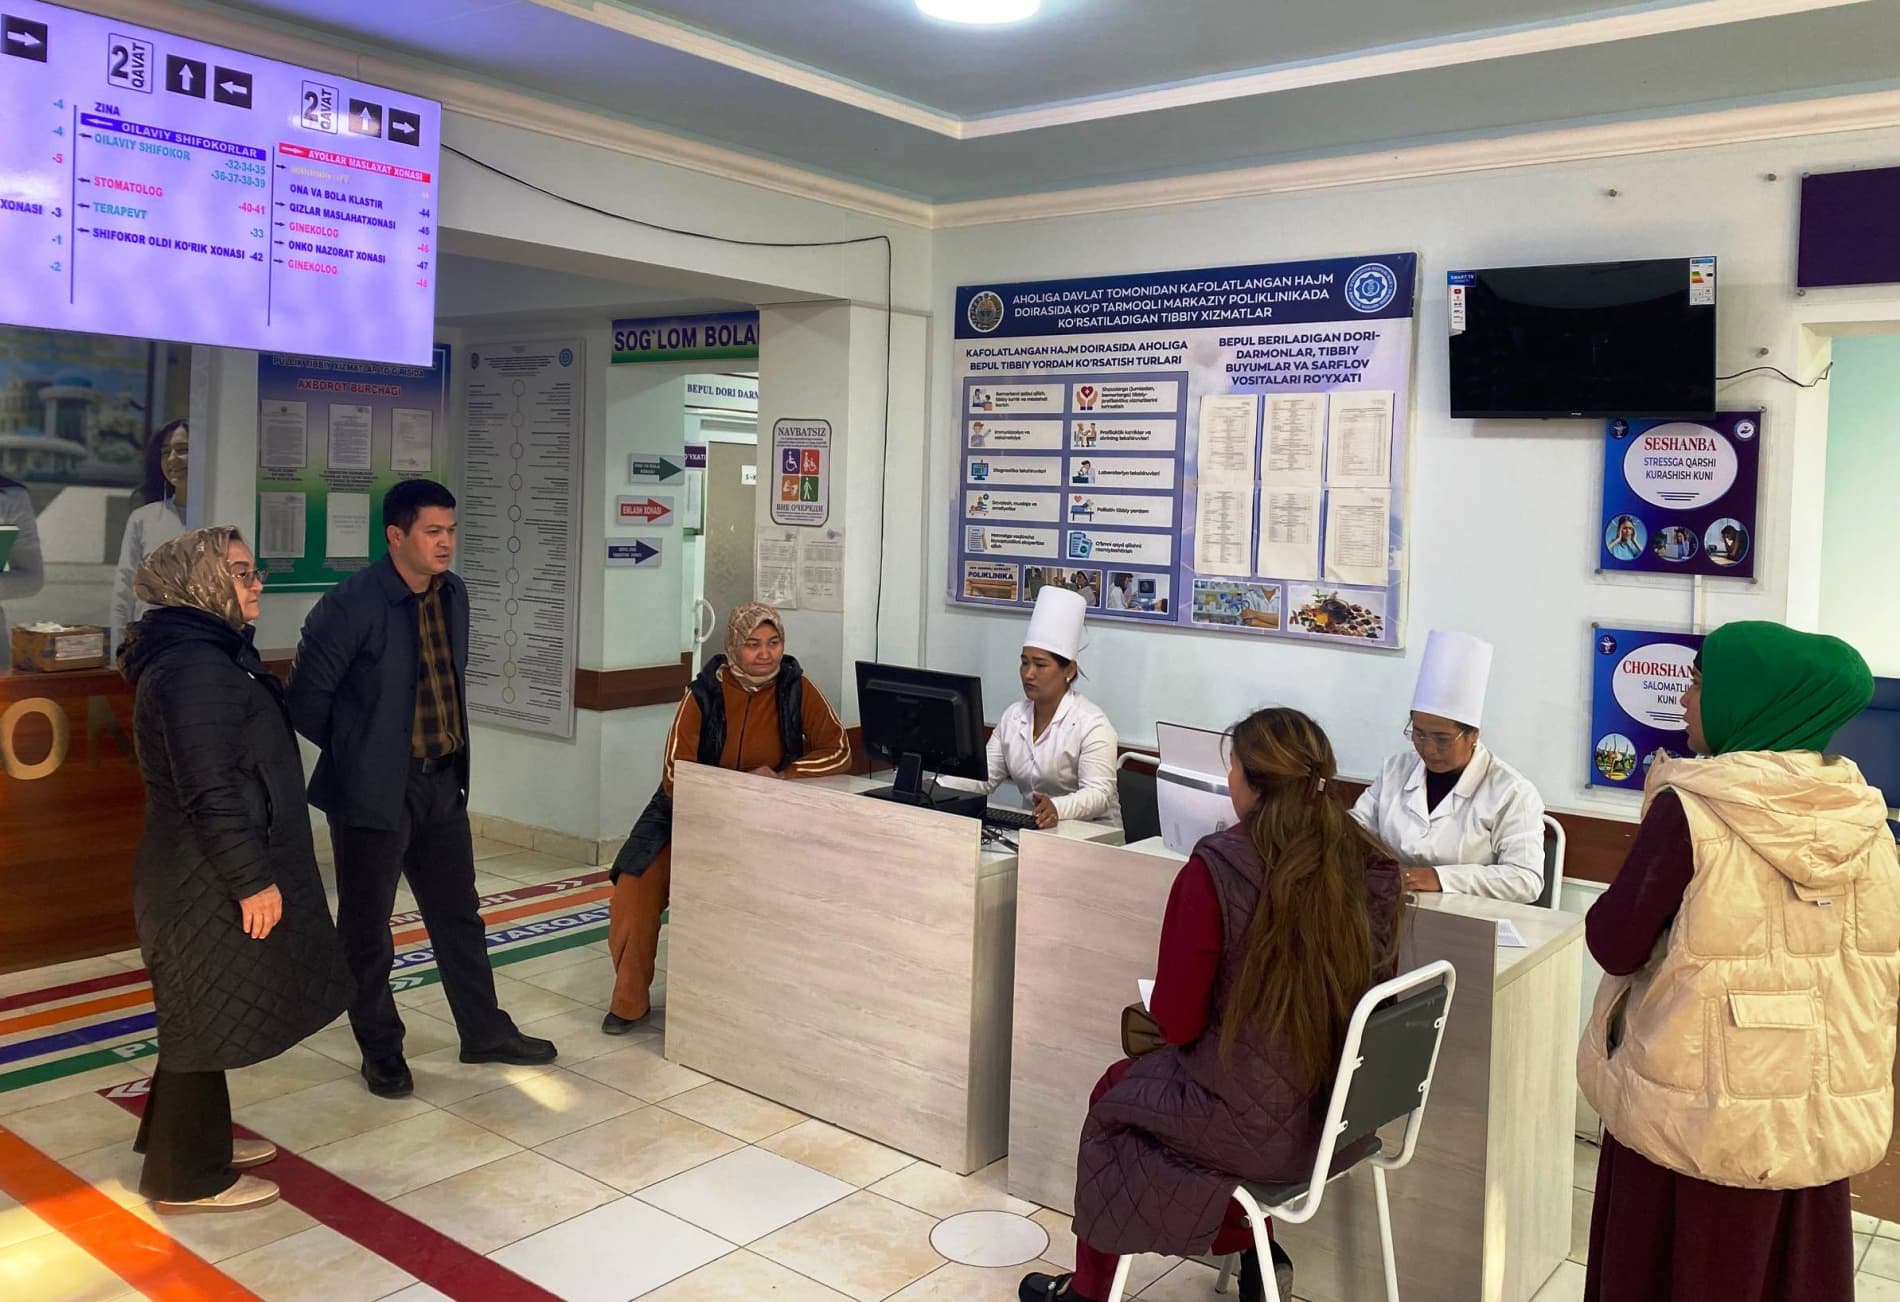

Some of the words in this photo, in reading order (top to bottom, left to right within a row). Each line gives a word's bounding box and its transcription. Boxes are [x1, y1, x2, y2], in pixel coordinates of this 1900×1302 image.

[111, 45, 129, 81] 2
[132, 43, 148, 89] QAVAT
[95, 102, 120, 117] ZINA
[304, 91, 318, 122] 2
[320, 88, 333, 131] QAVAT
[94, 133, 137, 151] OILAVIY
[139, 142, 190, 161] SHIFOKOR
[121, 121, 171, 142] OILAVIY
[175, 132, 257, 158] SHIFOKORLAR
[308, 150, 347, 167] AYOLLAR
[348, 157, 392, 175] MASLAXAT
[393, 167, 423, 181] XONASI
[94, 176, 163, 198] STOMATOLOG
[290, 184, 308, 196] ONA
[310, 187, 322, 199] VA
[324, 190, 347, 203] BOLA
[348, 193, 383, 210] KLASTIR
[51, 207, 62, 219] -3
[94, 202, 148, 220] TERAPEVT
[238, 201, 265, 216] -40-41
[289, 203, 321, 218] QIZLAR
[322, 208, 396, 230] MASLAHATXONASI
[418, 207, 430, 218] -44
[289, 221, 339, 238] GINEKOLOG
[93, 227, 146, 246] SHIFOKOR
[148, 234, 173, 249] OLDI
[175, 239, 208, 255] KO'RIK
[210, 245, 245, 260] XONASI
[249, 252, 263, 263] -42
[288, 240, 314, 253] ONKO
[315, 244, 354, 260] NAZORAT
[356, 251, 386, 265] XONASI
[288, 258, 338, 275] GINEKOLOG
[1012, 292, 1061, 305] AHOLIGA
[1063, 289, 1104, 301] DAVLAT
[1106, 284, 1179, 299] TOMONIDAN
[1180, 277, 1293, 294] KAFOLATLANGAN
[1294, 273, 1334, 287] HAJM
[1014, 305, 1072, 318] DOIRASIDA
[1074, 303, 1100, 315] KO'P
[1101, 300, 1161, 314] TARMOQLI
[1163, 295, 1225, 310] MARKAZIY
[1228, 289, 1330, 305] POLIKLINIKADA
[1058, 313, 1159, 329] KO'RSATILADIGAN
[1160, 311, 1200, 324] TIBBIY
[1200, 306, 1273, 321] XIZMATLAR
[705, 322, 759, 348] BOLA
[1218, 336, 1256, 348] BEPUL
[1257, 332, 1341, 346] BERILADIGAN
[1342, 330, 1381, 342] DORI-
[966, 345, 1050, 358] KAFOLATLANGAN
[1050, 344, 1080, 355] HAJM
[1080, 342, 1137, 354] DOIRASIDA
[1138, 340, 1188, 352] AHOLIGA
[1235, 347, 1316, 360] DARMONLAR,
[1317, 345, 1359, 357] TIBBIY
[969, 361, 1000, 372] BEPUL
[1001, 360, 1031, 371] TIBBIY
[1032, 359, 1073, 370] YORDAM
[1074, 356, 1134, 369] KO'RSATISH
[1135, 354, 1182, 366] TURLARI
[1225, 361, 1291, 373] BUYUMLAR
[1292, 360, 1310, 371] VA
[1311, 359, 1370, 370] SARFLOV
[298, 379, 347, 392] AXBOROT
[351, 381, 402, 397] BURCHAGI
[1231, 374, 1301, 386] VOSITALARI
[1303, 372, 1362, 384] RO'YXATI
[687, 383, 714, 396] BEPUL
[715, 385, 736, 397] DORI
[778, 426, 827, 438] NAVBATSIZ
[1644, 436, 1717, 451] SESHANBA
[1643, 457, 1684, 467] STRESSGA
[1685, 458, 1716, 469] QARSHI
[1645, 470, 1692, 480] KURASHISH
[1693, 471, 1714, 481] KUNI
[968, 571, 1014, 580] POLIKLINIKA
[1657, 695, 1677, 705] KUNI
